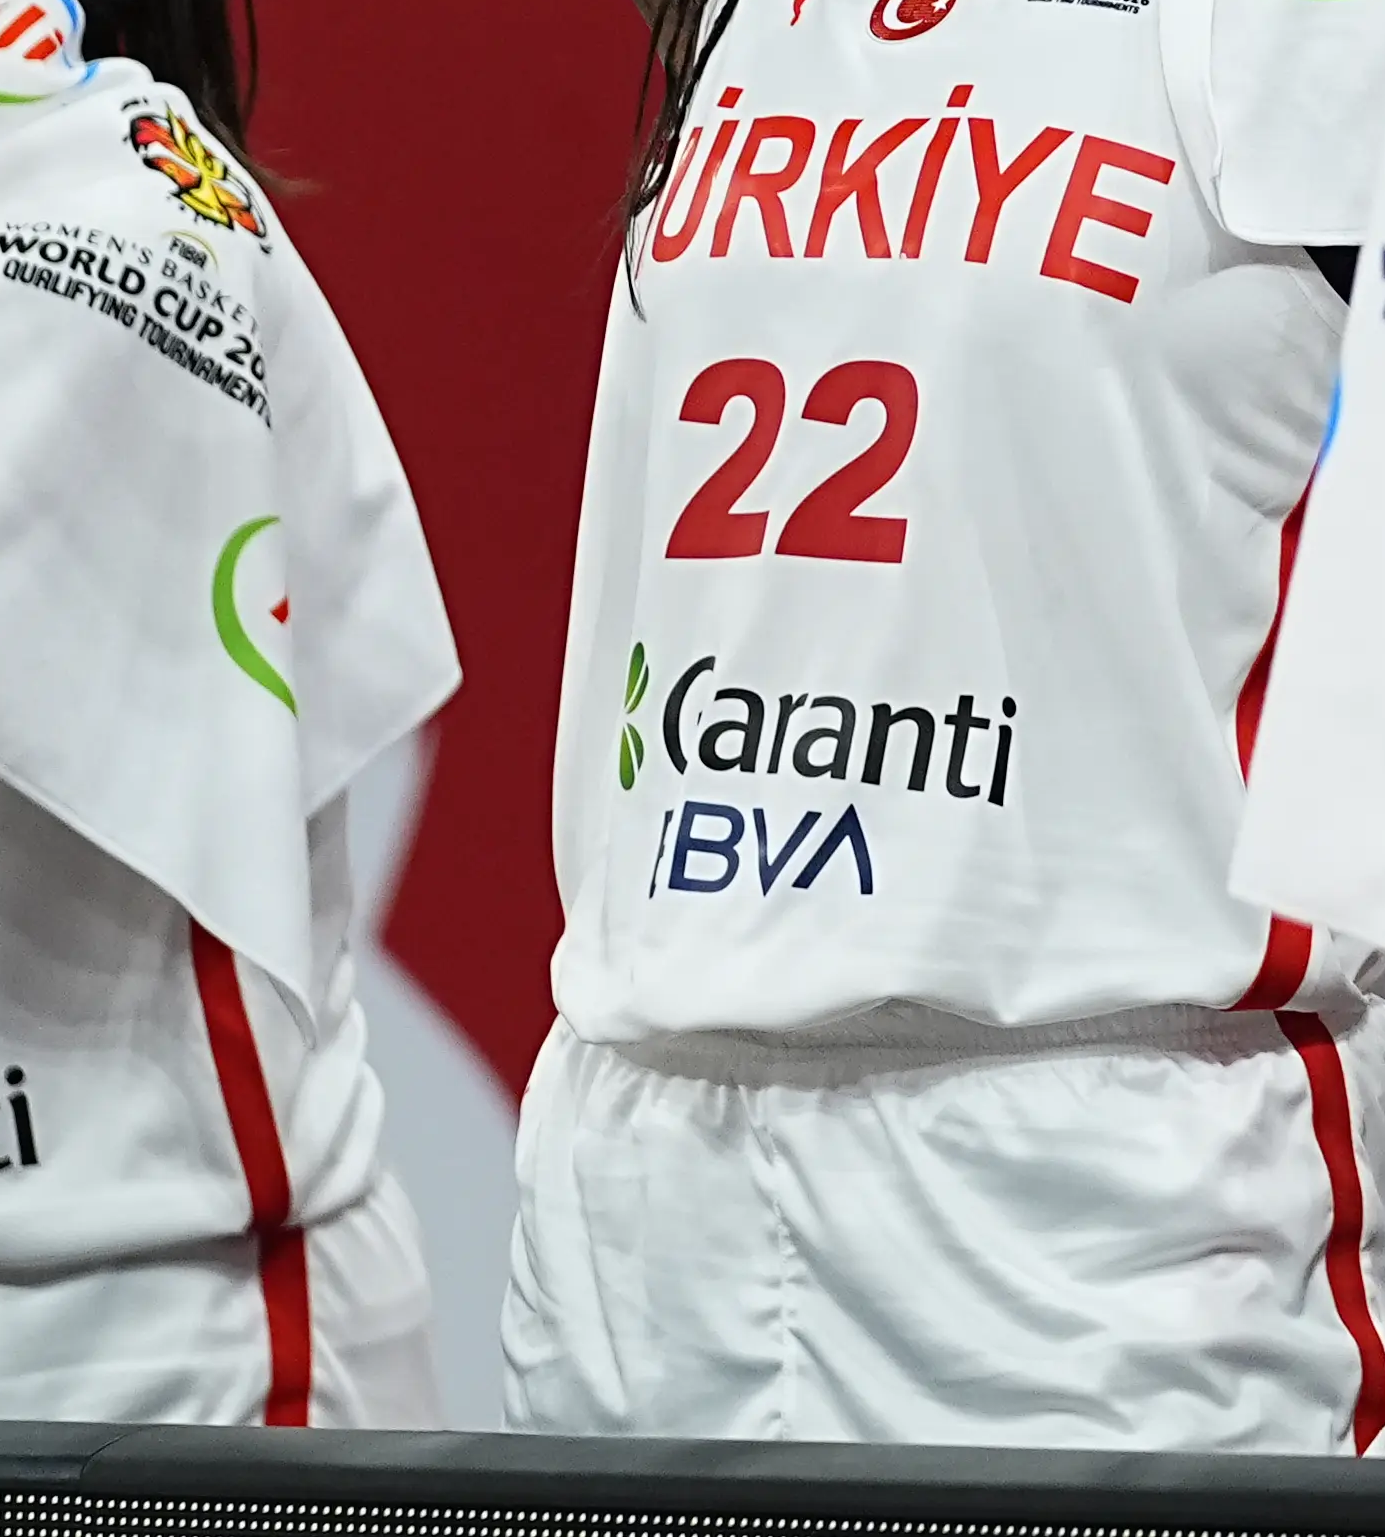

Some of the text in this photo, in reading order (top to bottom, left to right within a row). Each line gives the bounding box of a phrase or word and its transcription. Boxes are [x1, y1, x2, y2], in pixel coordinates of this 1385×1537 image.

[634, 82, 1176, 305] ÜRKİYE
[5, 219, 262, 335] WOMEN'S BASKET
[168, 234, 209, 272] FIBA
[2, 258, 274, 431] QUALIFYING TOURNAMENT
[153, 285, 224, 342] CUP
[665, 358, 920, 565] 22
[648, 800, 874, 900] BVA
